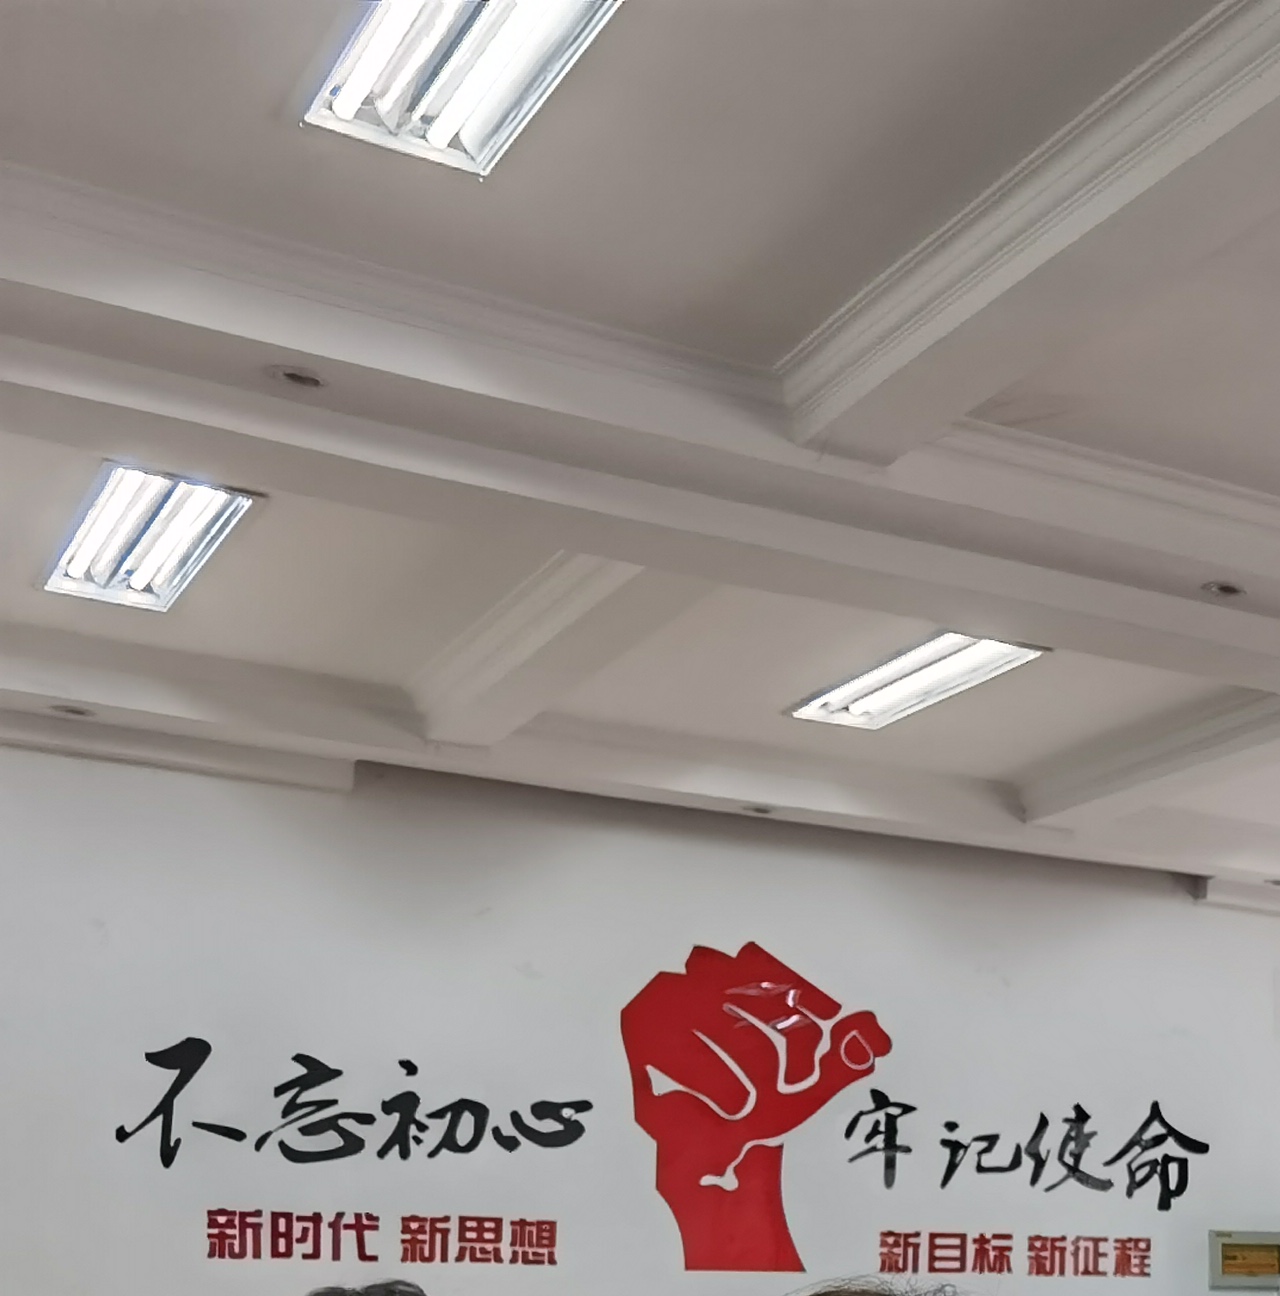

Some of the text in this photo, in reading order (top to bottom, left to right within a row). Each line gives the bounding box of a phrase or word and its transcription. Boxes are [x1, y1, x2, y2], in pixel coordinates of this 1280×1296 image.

[115, 1036, 594, 1169] 不忘初心
[844, 1088, 1210, 1212] 牢记使命
[206, 1208, 558, 1265] 新时代 新思想
[878, 1229, 1152, 1278] 新目标 新征程
